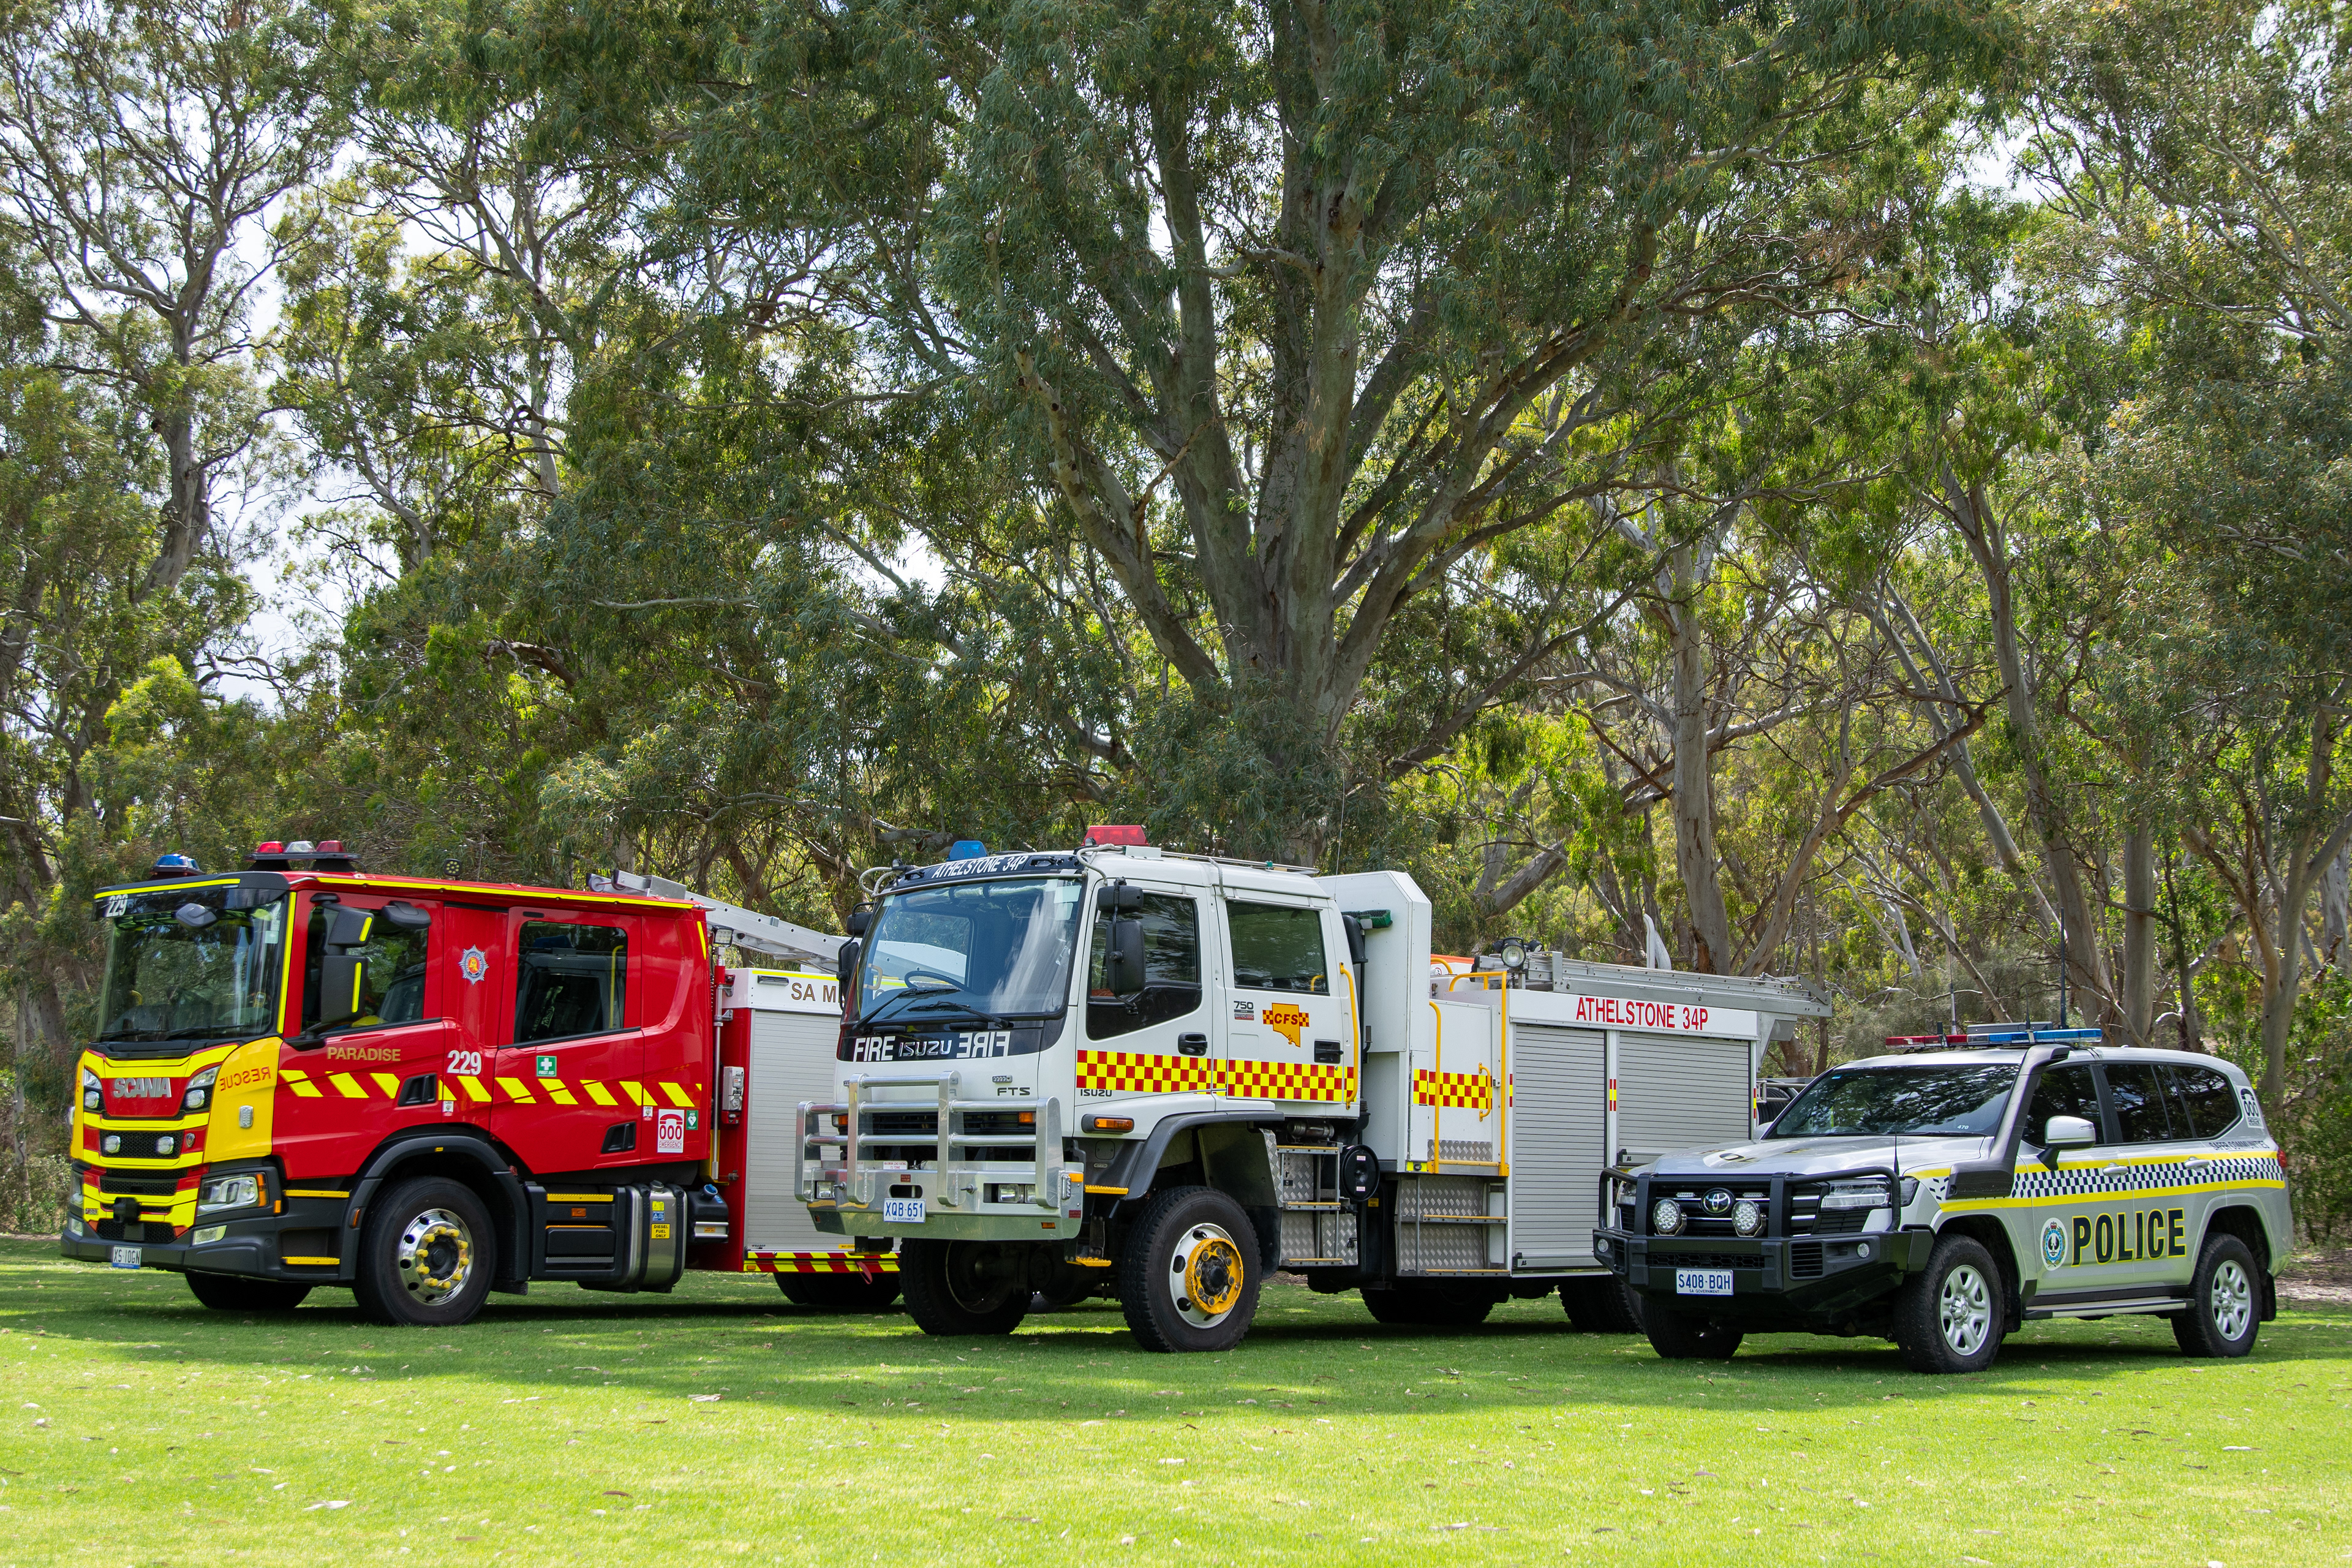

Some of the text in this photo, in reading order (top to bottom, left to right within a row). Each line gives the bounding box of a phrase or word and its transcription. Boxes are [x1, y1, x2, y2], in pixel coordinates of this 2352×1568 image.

[932, 855, 1029, 878] ATHELSTONE 34P
[106, 894, 128, 917] 229
[791, 982, 815, 1001] SA
[1234, 1001, 1254, 1009] 750
[1576, 997, 1709, 1031] ATHELSTONE 34P
[1274, 1013, 1298, 1025] CFS
[328, 1047, 401, 1062] PARADISE
[853, 1036, 952, 1062] FIRE ISUZU
[447, 1050, 482, 1075] 229
[113, 1077, 172, 1098] SCANIA
[997, 1087, 1030, 1096] FTS
[2244, 1100, 2259, 1117] 000
[660, 1125, 682, 1140] 000
[2071, 1207, 2187, 1268] POLICE
